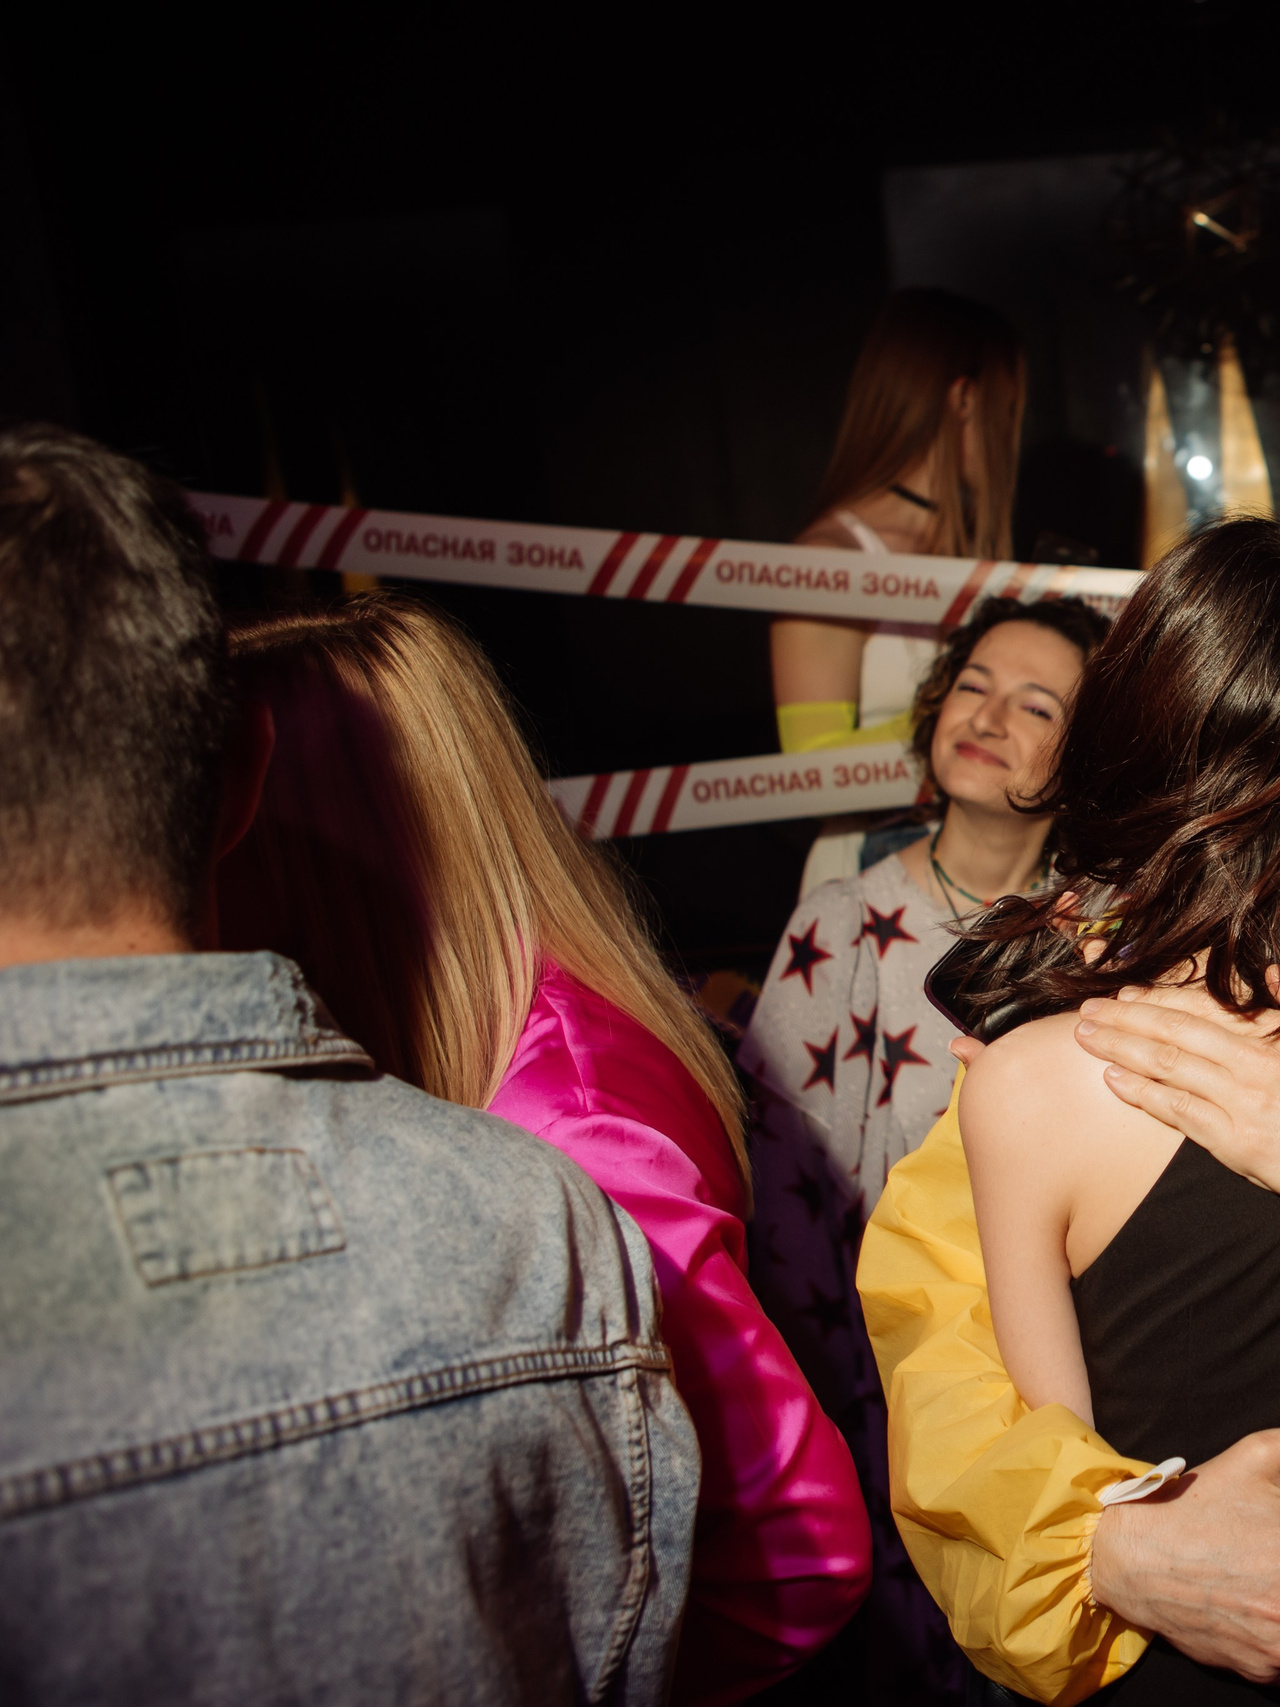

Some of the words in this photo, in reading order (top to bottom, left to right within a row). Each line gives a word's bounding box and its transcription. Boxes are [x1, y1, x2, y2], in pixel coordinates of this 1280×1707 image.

[362, 526, 496, 563] ОПАСНАЯ
[506, 540, 586, 571] ЗОНА
[715, 558, 850, 592] ОПАСНАЯ
[862, 571, 941, 600] ЗОНА
[691, 768, 823, 804] ОПАСНАЯ
[833, 758, 911, 788] ЗОНА
